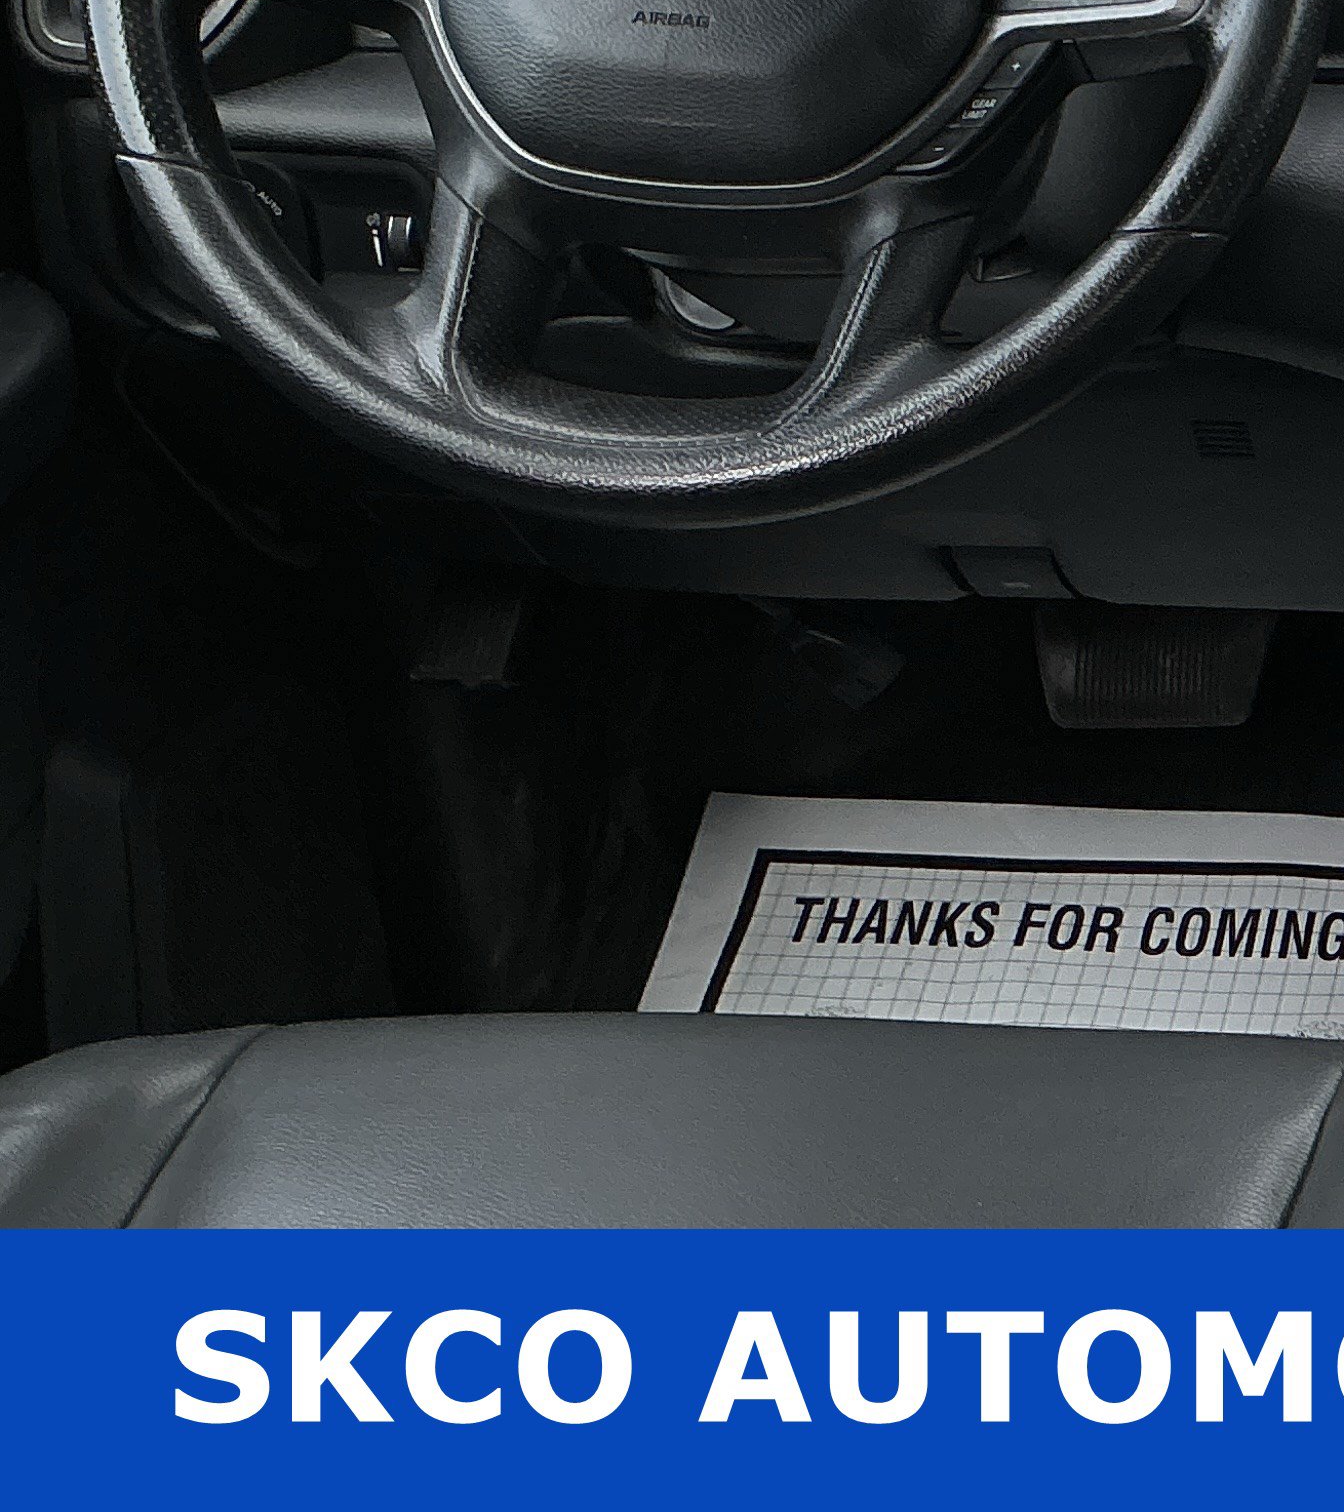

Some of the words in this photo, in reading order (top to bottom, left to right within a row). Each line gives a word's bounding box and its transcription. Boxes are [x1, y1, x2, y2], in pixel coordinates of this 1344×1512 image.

[631, 10, 711, 29] AIRBAG
[790, 896, 1003, 948] THANKS
[1013, 901, 1126, 955] FOR
